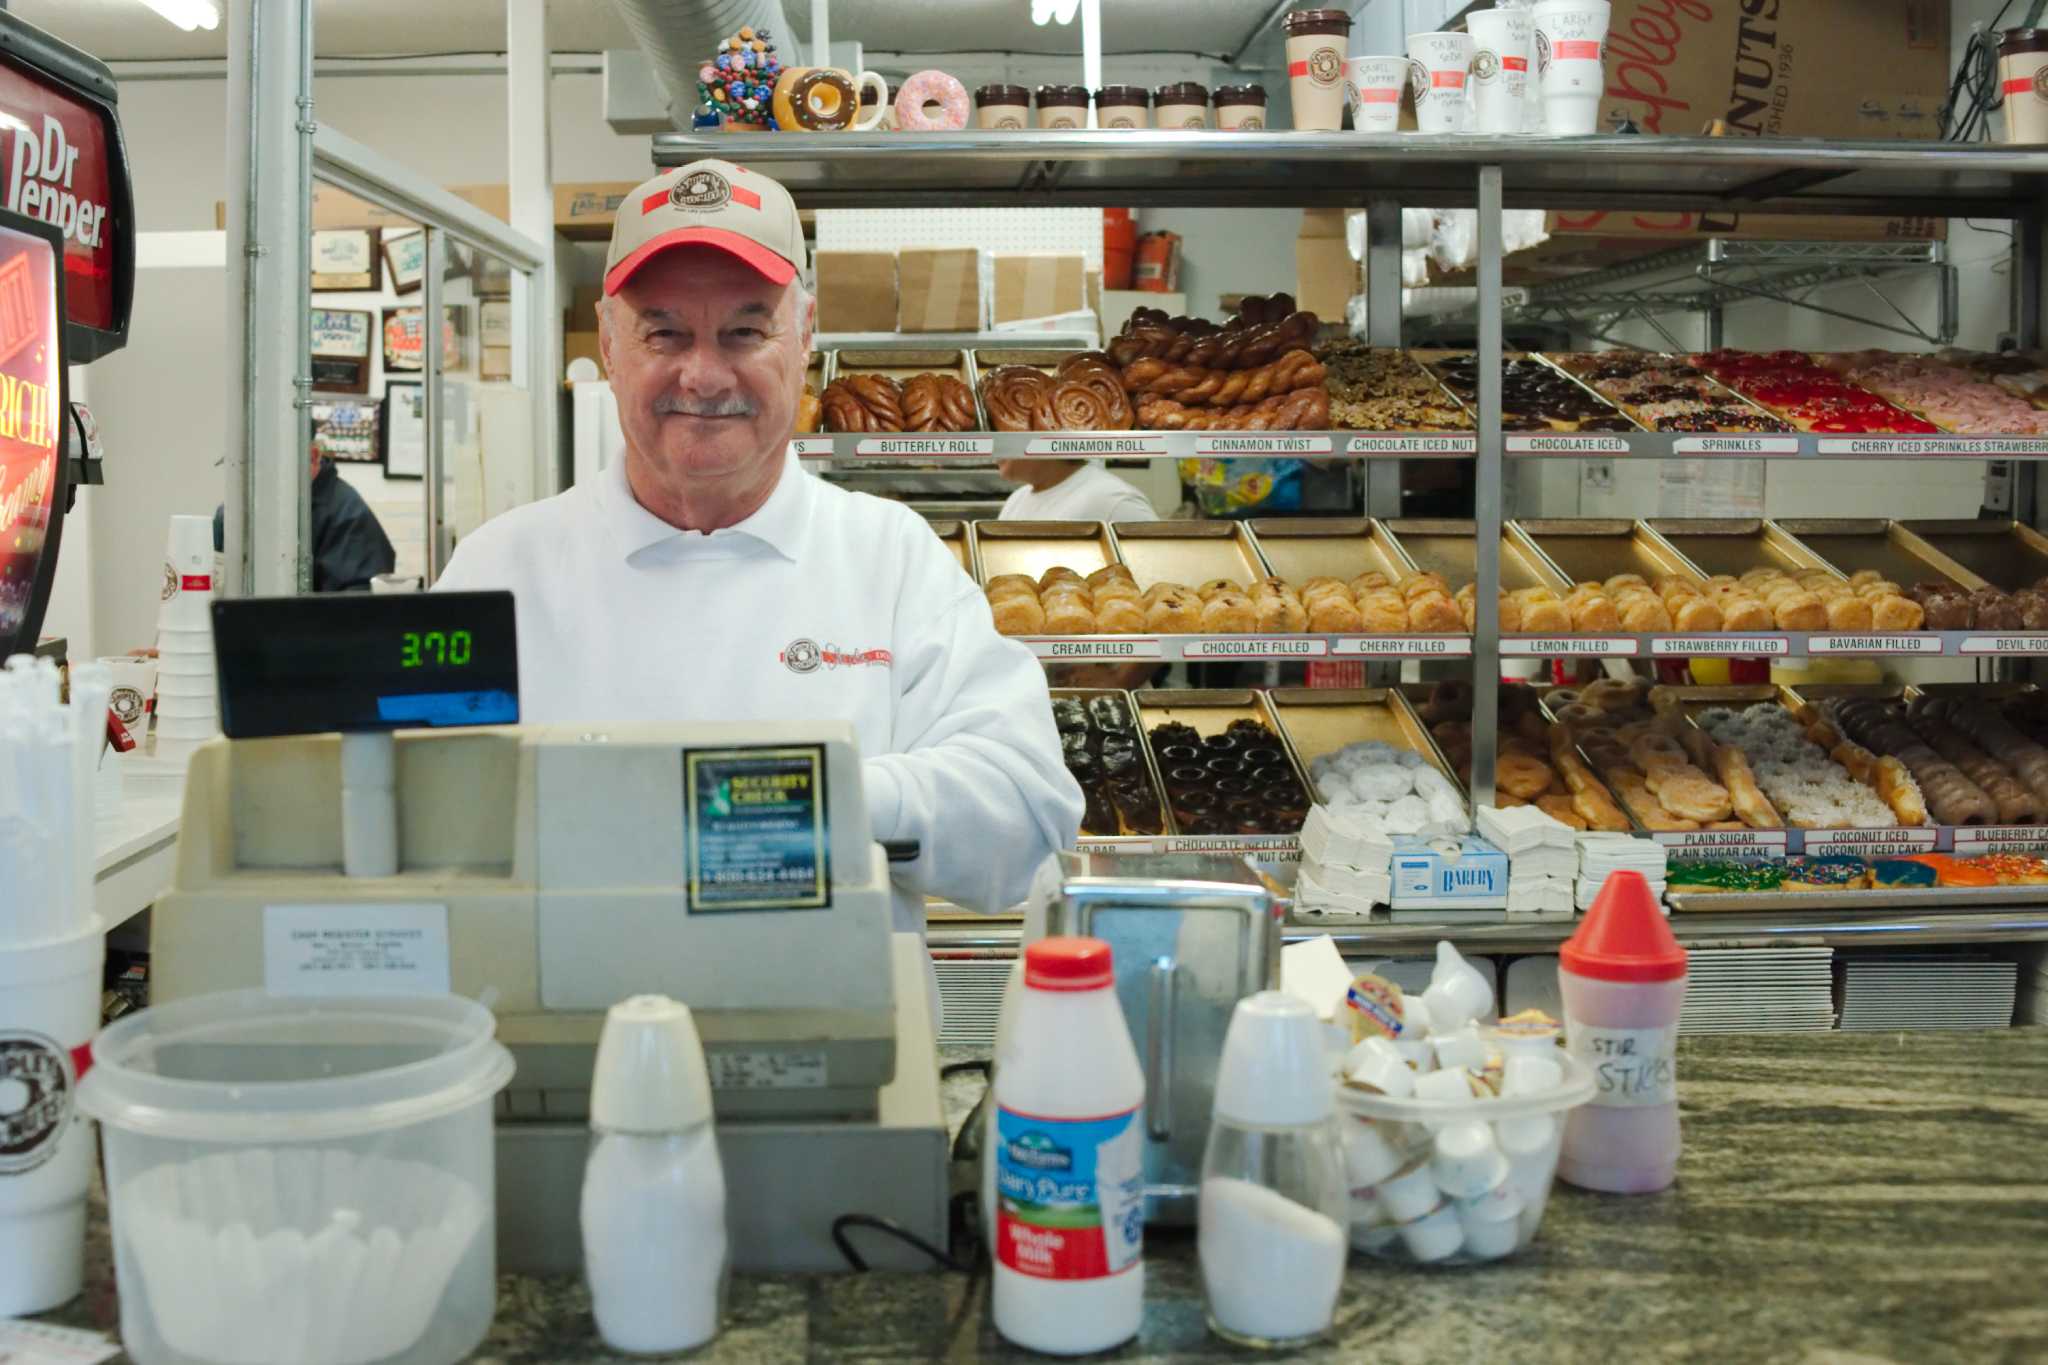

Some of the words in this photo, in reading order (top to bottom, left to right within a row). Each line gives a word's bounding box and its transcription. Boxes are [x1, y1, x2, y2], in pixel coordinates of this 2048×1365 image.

[40, 114, 79, 188] Dr
[881, 441, 946, 453] BUTTERFLY
[950, 441, 979, 452] ROLL
[1051, 440, 1112, 452] CINNAMON
[1116, 440, 1146, 451] ROLL
[1211, 440, 1273, 451] CINNAMON
[1277, 439, 1312, 450] TWIST
[1354, 440, 1419, 451] CHOCOLATE
[1423, 440, 1447, 451] ICED
[1451, 440, 1474, 451] NUT
[1529, 439, 1590, 450] CHOCOLATE
[1594, 439, 1623, 450] ICED
[1701, 439, 1762, 451] SPRINKLES
[1851, 440, 1894, 452] CHERRY
[1897, 440, 1921, 452] ICED
[1924, 440, 1982, 452] SPRINKLES
[1052, 643, 1092, 654] CREAM
[1095, 643, 1134, 654] FILLED
[1202, 642, 1268, 654] CHOCOLATE
[1272, 642, 1310, 653] FILLED
[1360, 640, 1404, 652] CHERRY
[1408, 640, 1446, 651] FILLED
[1530, 640, 1569, 652] LEMON
[1572, 640, 1609, 651] FILLED
[1664, 640, 1739, 652] STRAWBERRY
[1742, 640, 1778, 652] FILLED
[1829, 638, 1882, 650] BAVARIAN
[1885, 638, 1921, 650] FILLED
[1996, 638, 2026, 650] DEVIL
[1685, 832, 1717, 845] PLAIN
[1720, 832, 1756, 844] SUGAR
[1833, 831, 1882, 843] COCONUT
[1885, 831, 1909, 842] ICED
[1975, 829, 2034, 841] BLUEBERRY
[1175, 840, 1233, 850] CHOCOLATE
[1271, 839, 1300, 850] CAKE
[1819, 844, 1870, 856] COCONUT
[1872, 844, 1895, 855] ICED
[1898, 844, 1923, 854] CAKE
[1988, 843, 2024, 853] GLAZED
[1257, 852, 1276, 863] NUT
[1279, 851, 1303, 863] CAKE
[1669, 847, 1700, 859] PLAIN
[1703, 847, 1739, 858] SUGAR
[1743, 846, 1769, 857] CAKE
[1592, 1037, 1637, 1056] STIR
[1008, 1222, 1064, 1249] Whole
[1017, 1245, 1053, 1264] Milk
